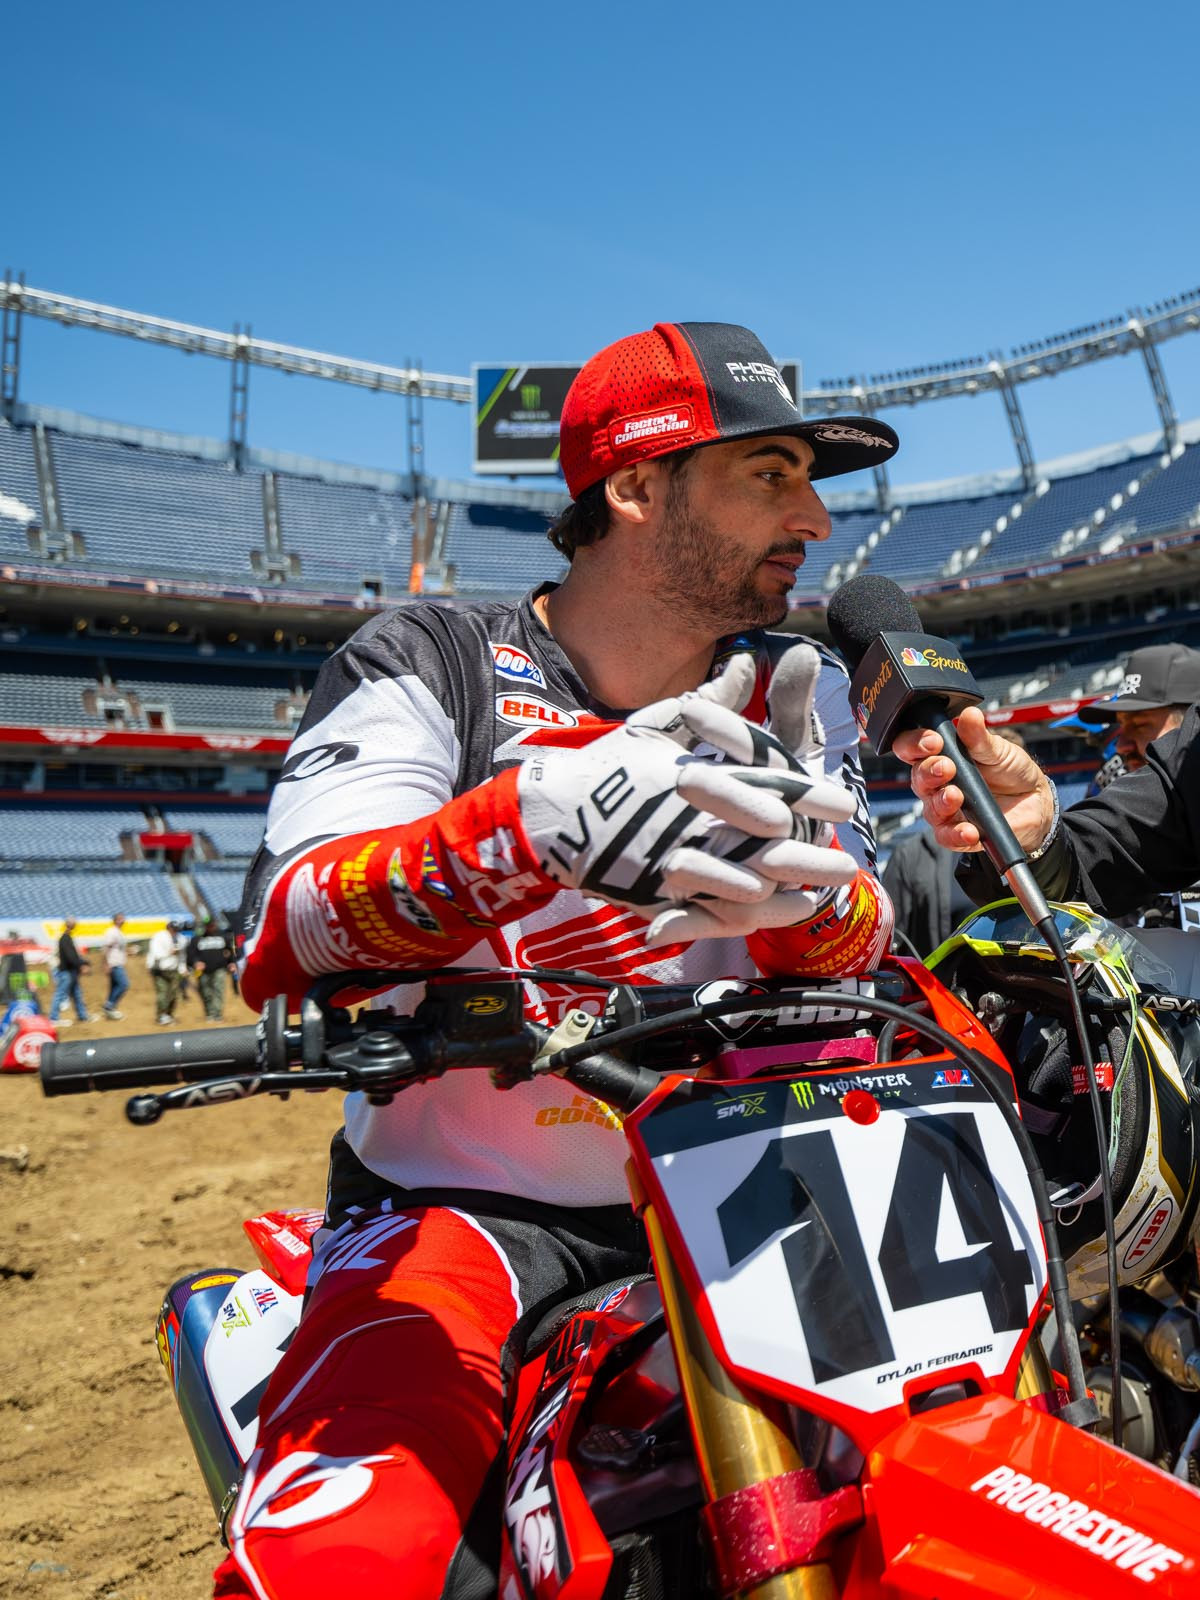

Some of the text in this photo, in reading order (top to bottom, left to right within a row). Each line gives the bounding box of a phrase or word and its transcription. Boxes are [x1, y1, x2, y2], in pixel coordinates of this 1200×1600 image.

[733, 375, 774, 383] RACING
[624, 413, 678, 432] Factory
[922, 648, 969, 674] Sports
[861, 660, 893, 713] Sports
[502, 699, 566, 726] BELL
[1142, 996, 1192, 1012] ASV
[819, 1073, 912, 1097] MONSTER
[931, 1069, 974, 1087] AMA
[182, 1077, 262, 1107] ASV
[716, 1095, 768, 1118] SMX
[1127, 1209, 1169, 1261] BELL
[716, 1112, 1034, 1385] 14
[876, 1343, 994, 1385] DYLAN FERRANDIS
[970, 1465, 1185, 1582] PROGRESSIVE
